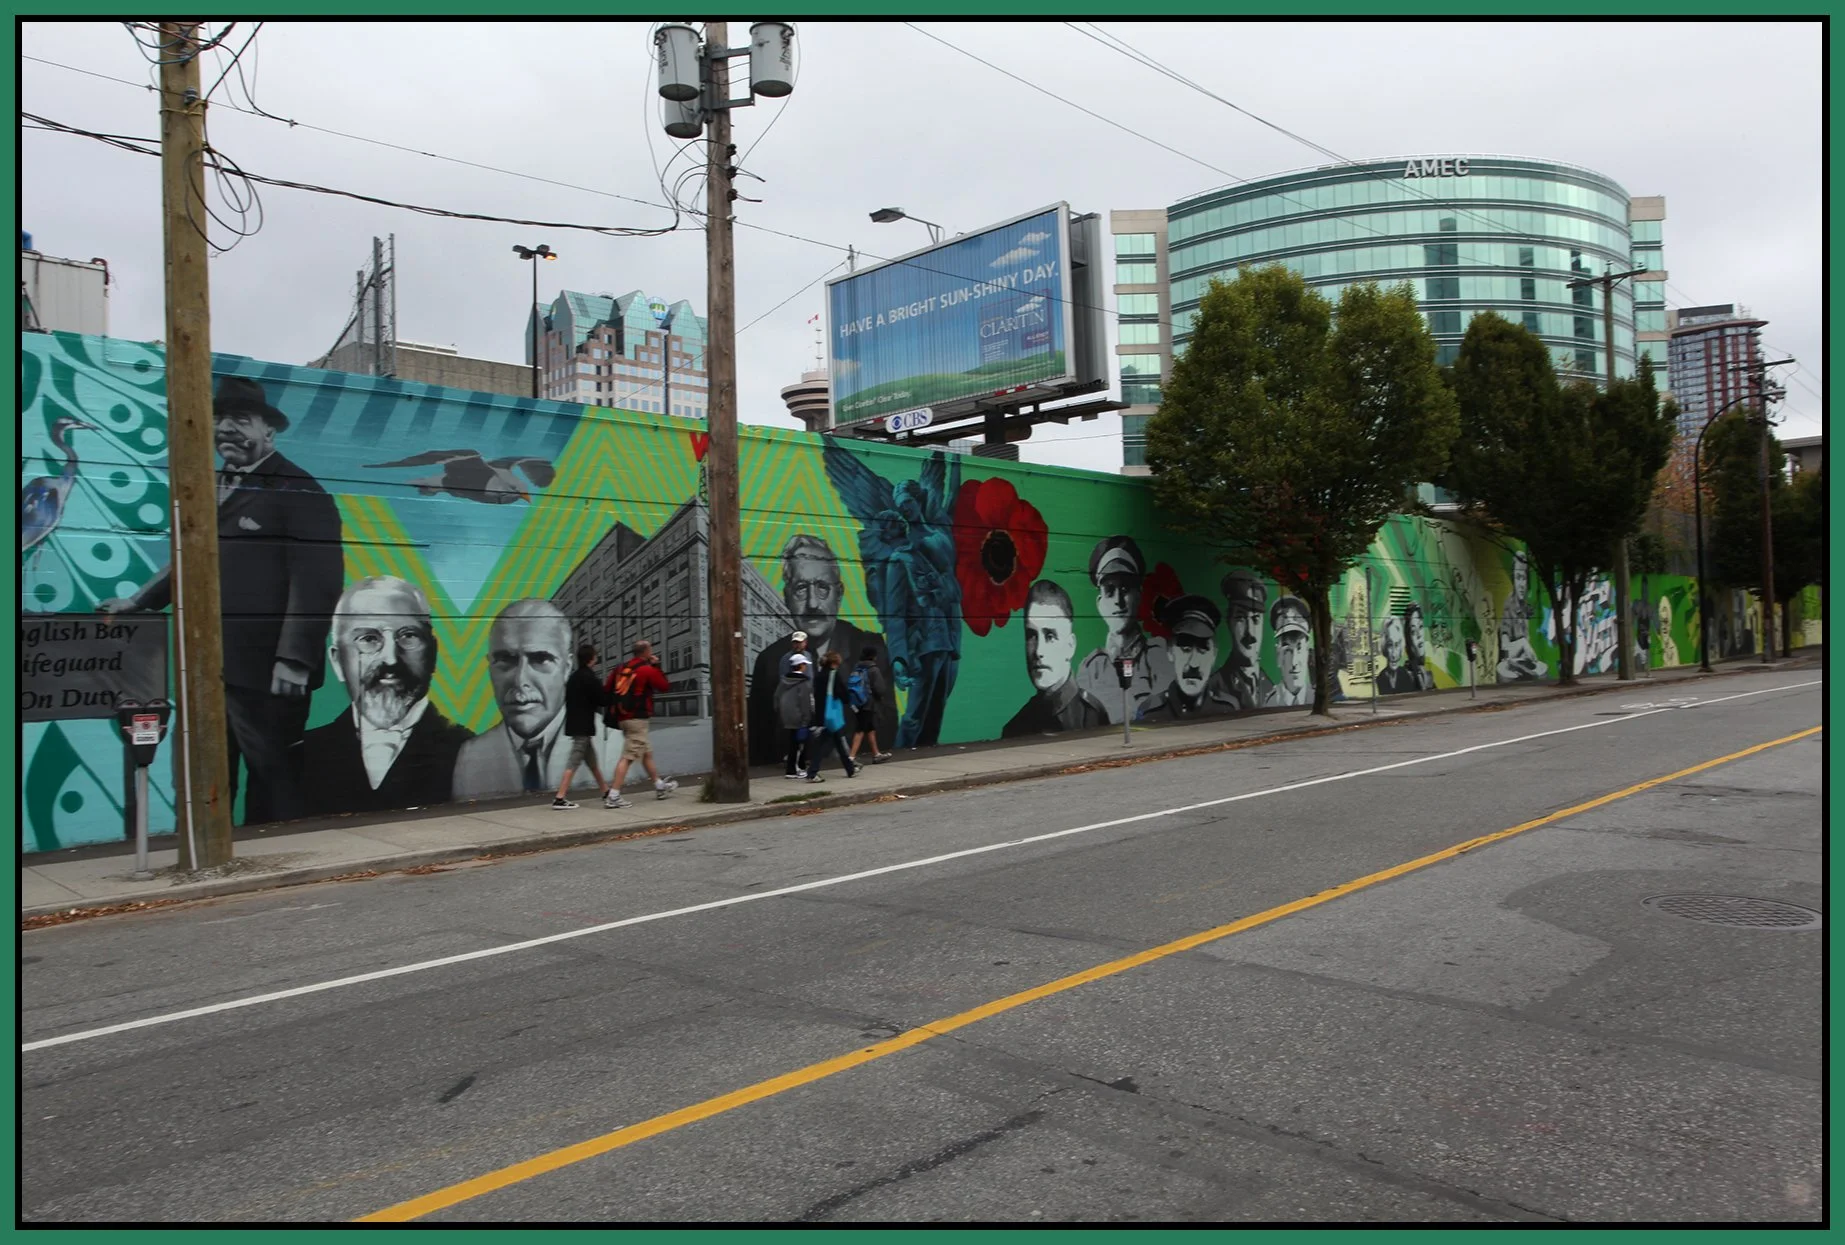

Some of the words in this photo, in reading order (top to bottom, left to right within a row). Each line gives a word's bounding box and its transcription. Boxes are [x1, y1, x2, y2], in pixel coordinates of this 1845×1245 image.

[1403, 159, 1469, 178] AMEC
[840, 316, 873, 338] HAVE
[876, 313, 886, 327] A
[888, 297, 937, 324] BRIGHT
[940, 272, 1018, 309] SUN-SHINY
[1023, 261, 1059, 285] DAY.
[980, 309, 1045, 338] CLARITIN
[903, 410, 928, 428] CBS
[22, 621, 87, 648] glish
[95, 623, 138, 643] Bay
[23, 651, 123, 677] ifeguard
[22, 691, 53, 710] On
[60, 689, 122, 709] Duty
